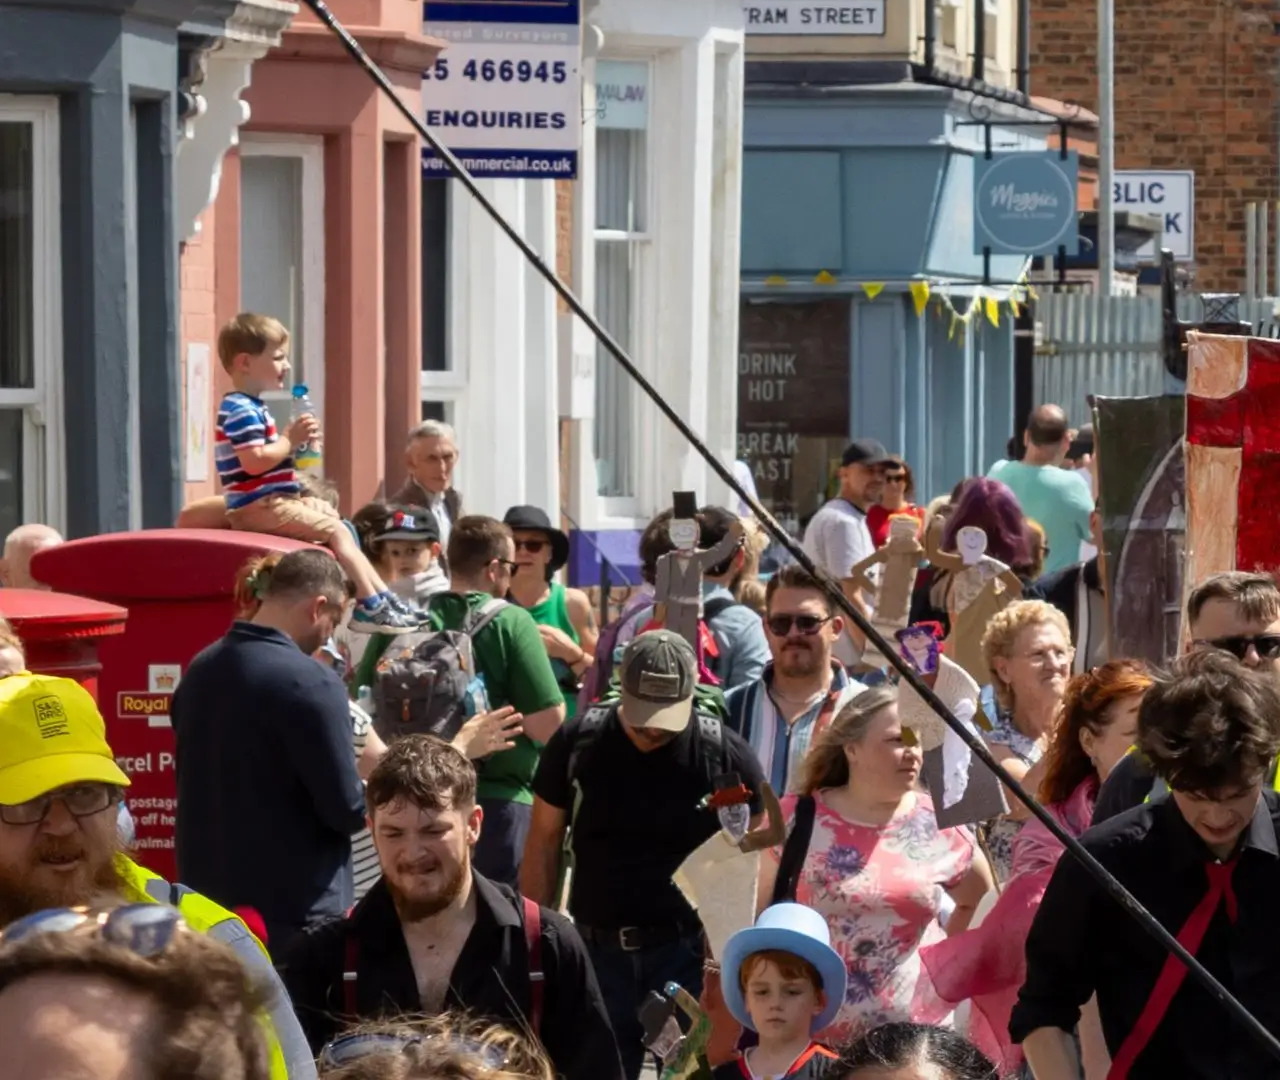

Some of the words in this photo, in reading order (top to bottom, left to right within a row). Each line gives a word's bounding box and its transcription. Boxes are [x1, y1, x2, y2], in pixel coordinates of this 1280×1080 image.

[744, 7, 789, 25] RAM
[800, 7, 877, 24] STREET
[463, 59, 567, 83] 466945
[426, 109, 567, 129] ENQUIRIES
[738, 353, 797, 376] DRINK
[748, 380, 787, 401] HOT
[753, 457, 792, 481] AST
[123, 695, 169, 714] Royal
